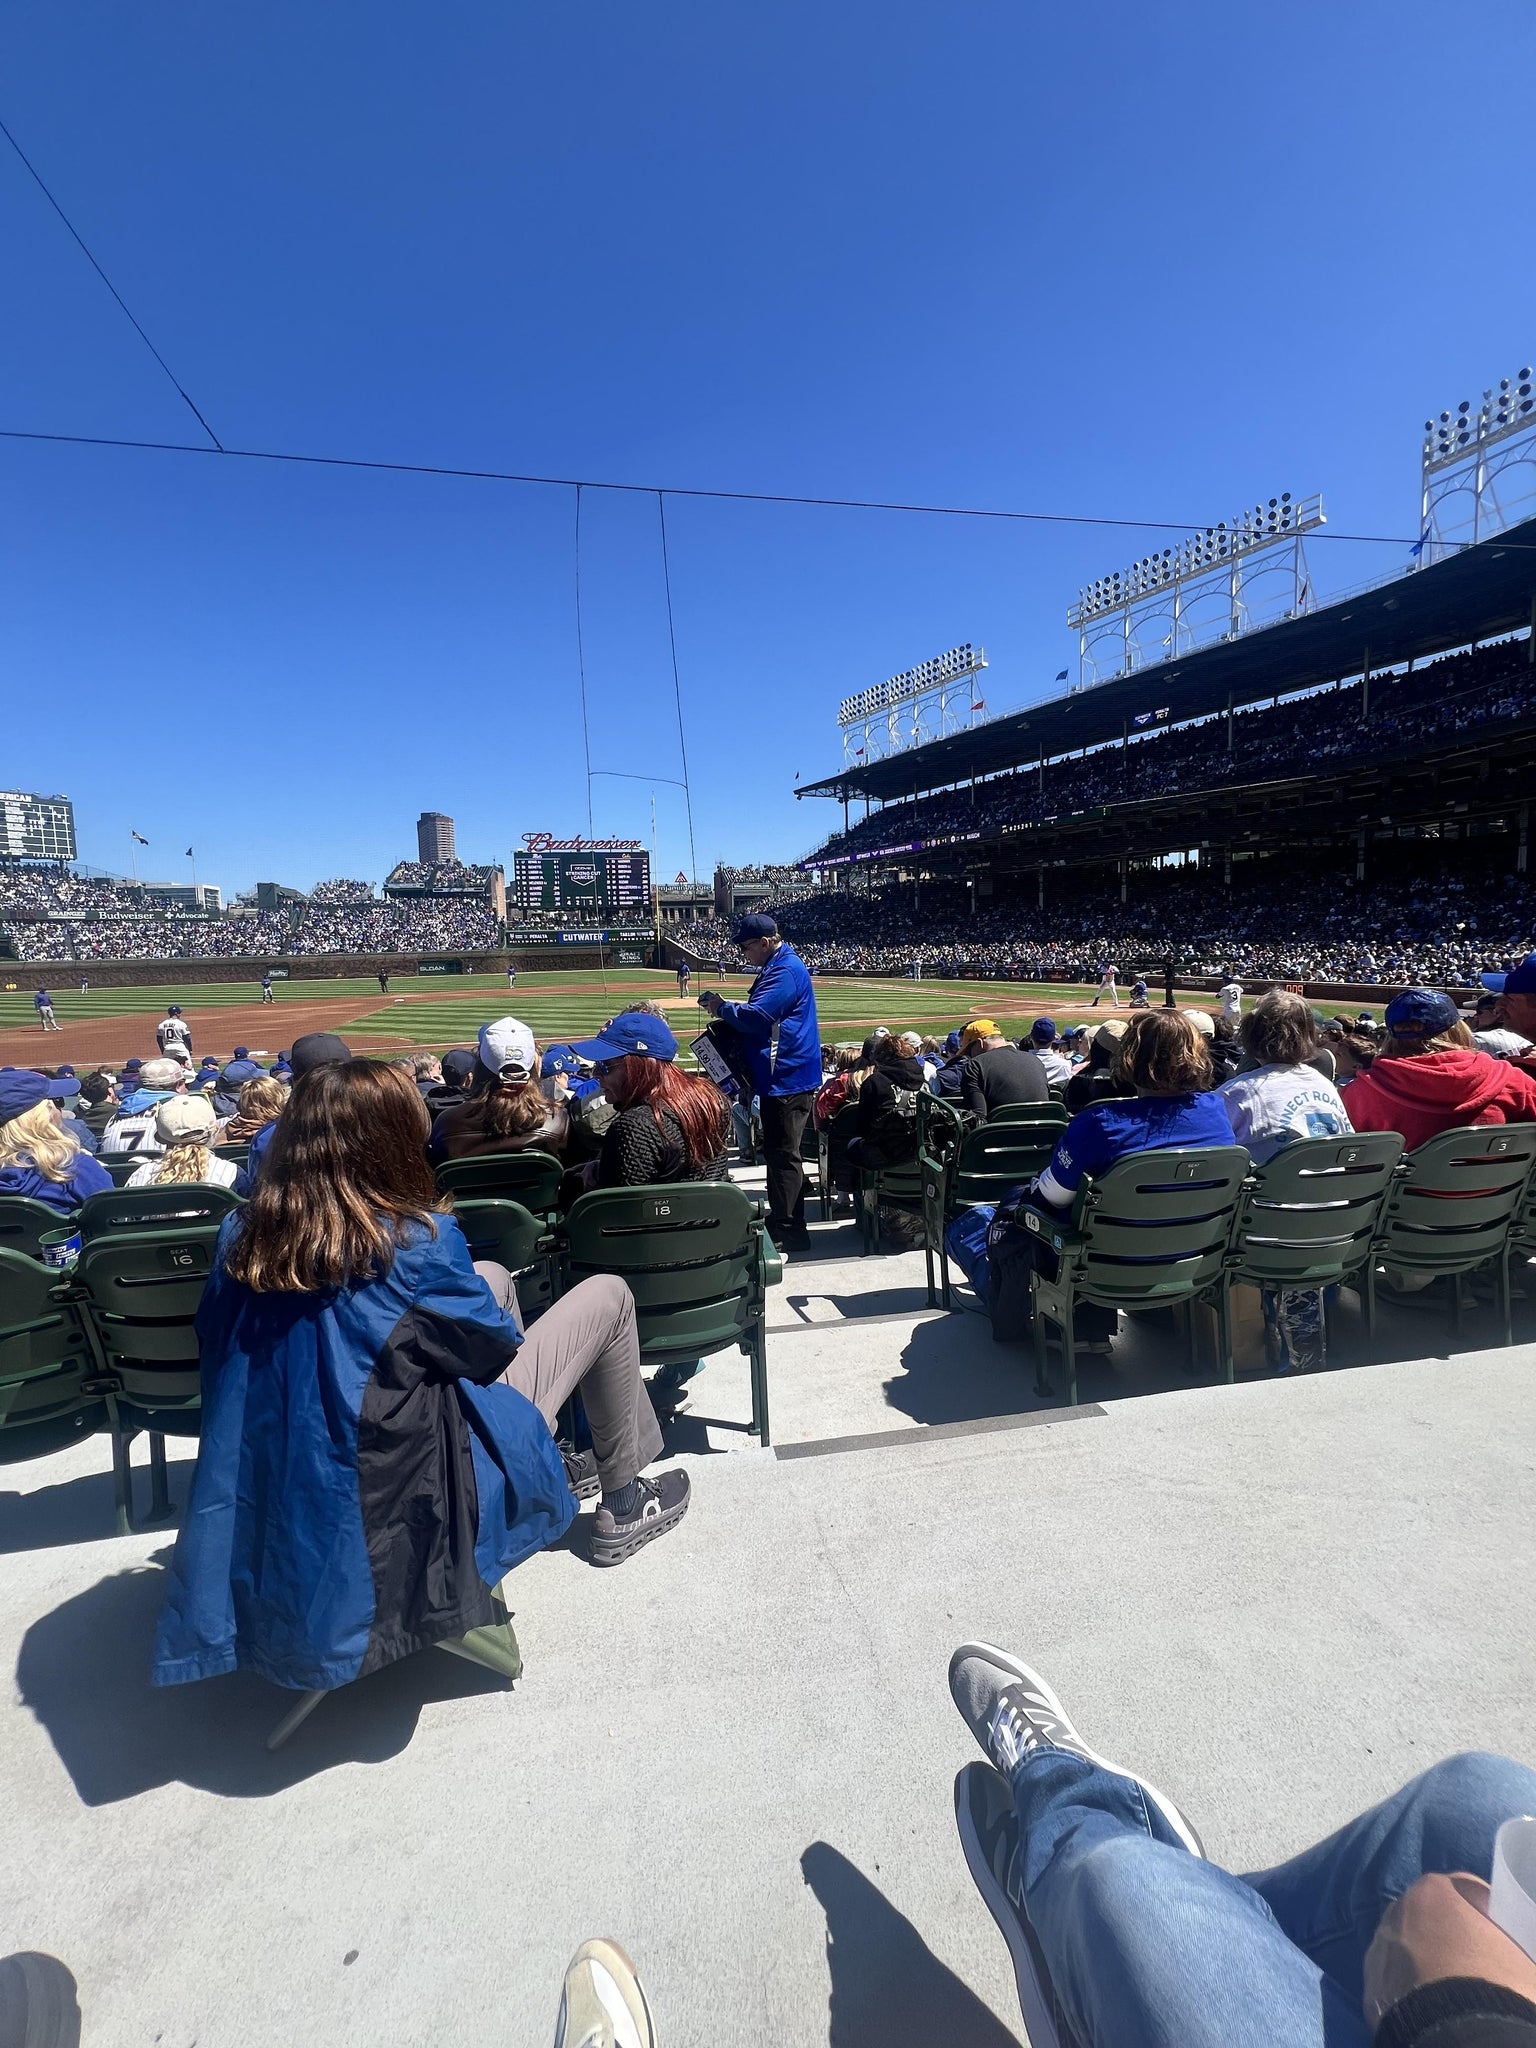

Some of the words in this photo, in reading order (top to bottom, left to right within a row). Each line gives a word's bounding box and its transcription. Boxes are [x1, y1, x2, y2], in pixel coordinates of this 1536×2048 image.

[522, 833, 641, 853] Budweiser
[99, 912, 155, 920] Budweiser
[563, 933, 603, 942] CUTWATER
[1231, 990, 1238, 1000] 3
[695, 1045, 711, 1064] 14.99
[120, 1130, 146, 1151] 7
[1498, 1143, 1507, 1151] 3
[1348, 1153, 1356, 1161] 2
[655, 1206, 671, 1216] 18
[173, 1255, 193, 1266] 16
